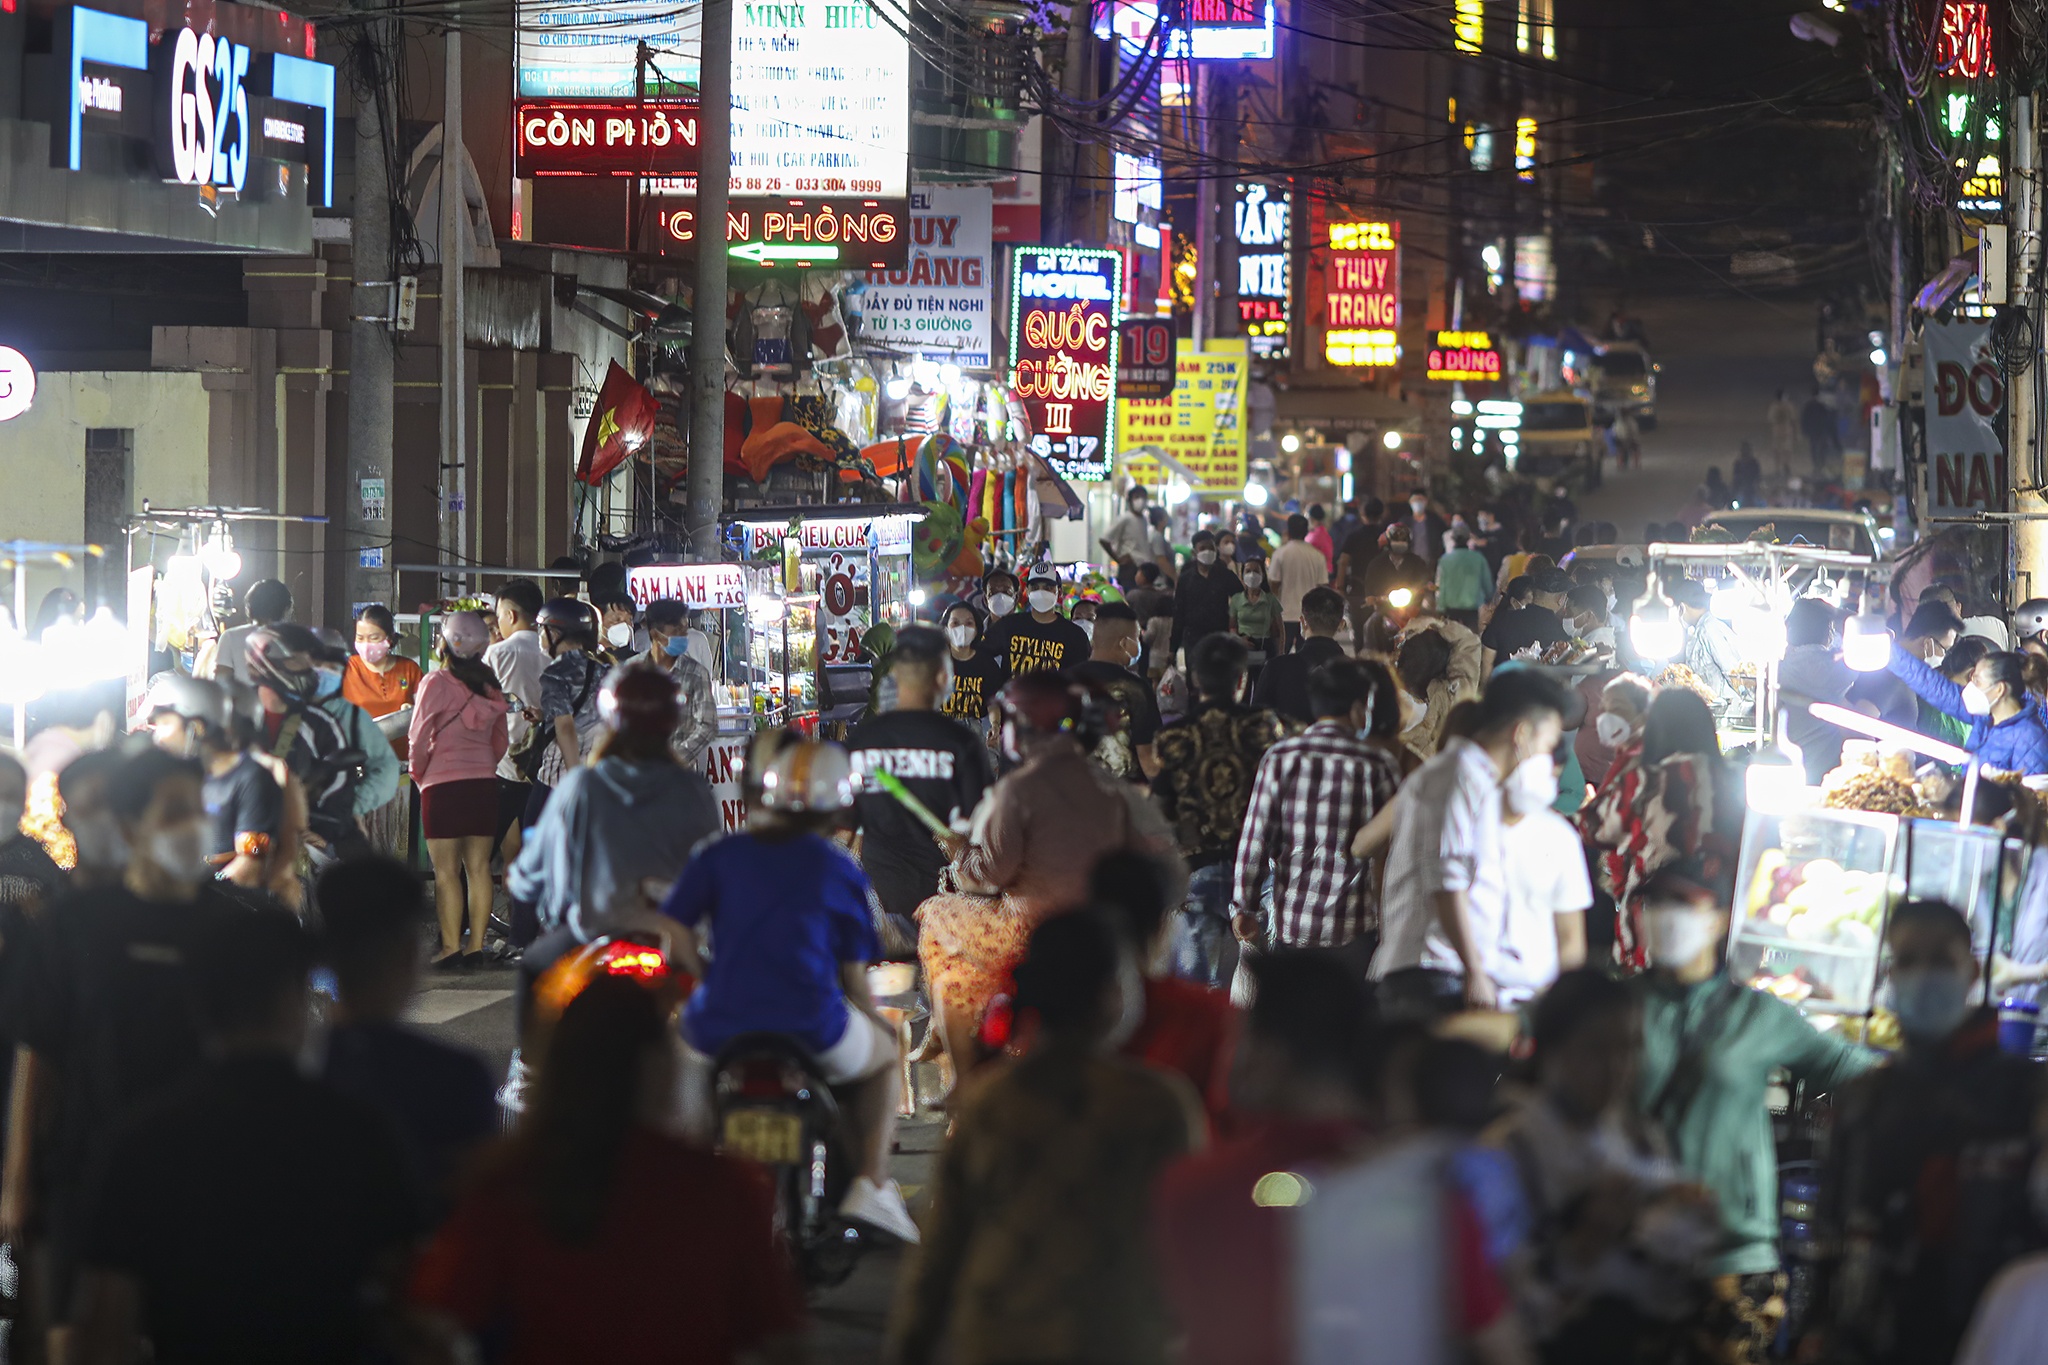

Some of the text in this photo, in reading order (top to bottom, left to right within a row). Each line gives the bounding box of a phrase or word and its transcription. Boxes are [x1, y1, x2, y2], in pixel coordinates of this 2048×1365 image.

[744, 4, 805, 29] MINH
[171, 26, 250, 192] GS25
[525, 110, 596, 146] CÒN
[746, 178, 762, 191] 88
[766, 178, 781, 191] 26
[796, 178, 819, 191] 033
[823, 178, 846, 192] 304
[851, 179, 882, 192] 9999
[669, 204, 897, 243] CN PHÒNG
[1020, 271, 1112, 301] HOTEL
[917, 294, 945, 316] TIỆN
[948, 298, 984, 313] NGHI
[1326, 292, 1396, 328] TRANG
[893, 317, 911, 331] 1-3
[915, 314, 973, 332] GIƯỜNG
[1025, 297, 1108, 351] QUỐC
[1127, 324, 1169, 365] 19
[1015, 349, 1111, 401] CƯỜNG
[1044, 402, 1073, 434] III
[833, 524, 866, 548] CUA
[1009, 635, 1065, 661] STYLING
